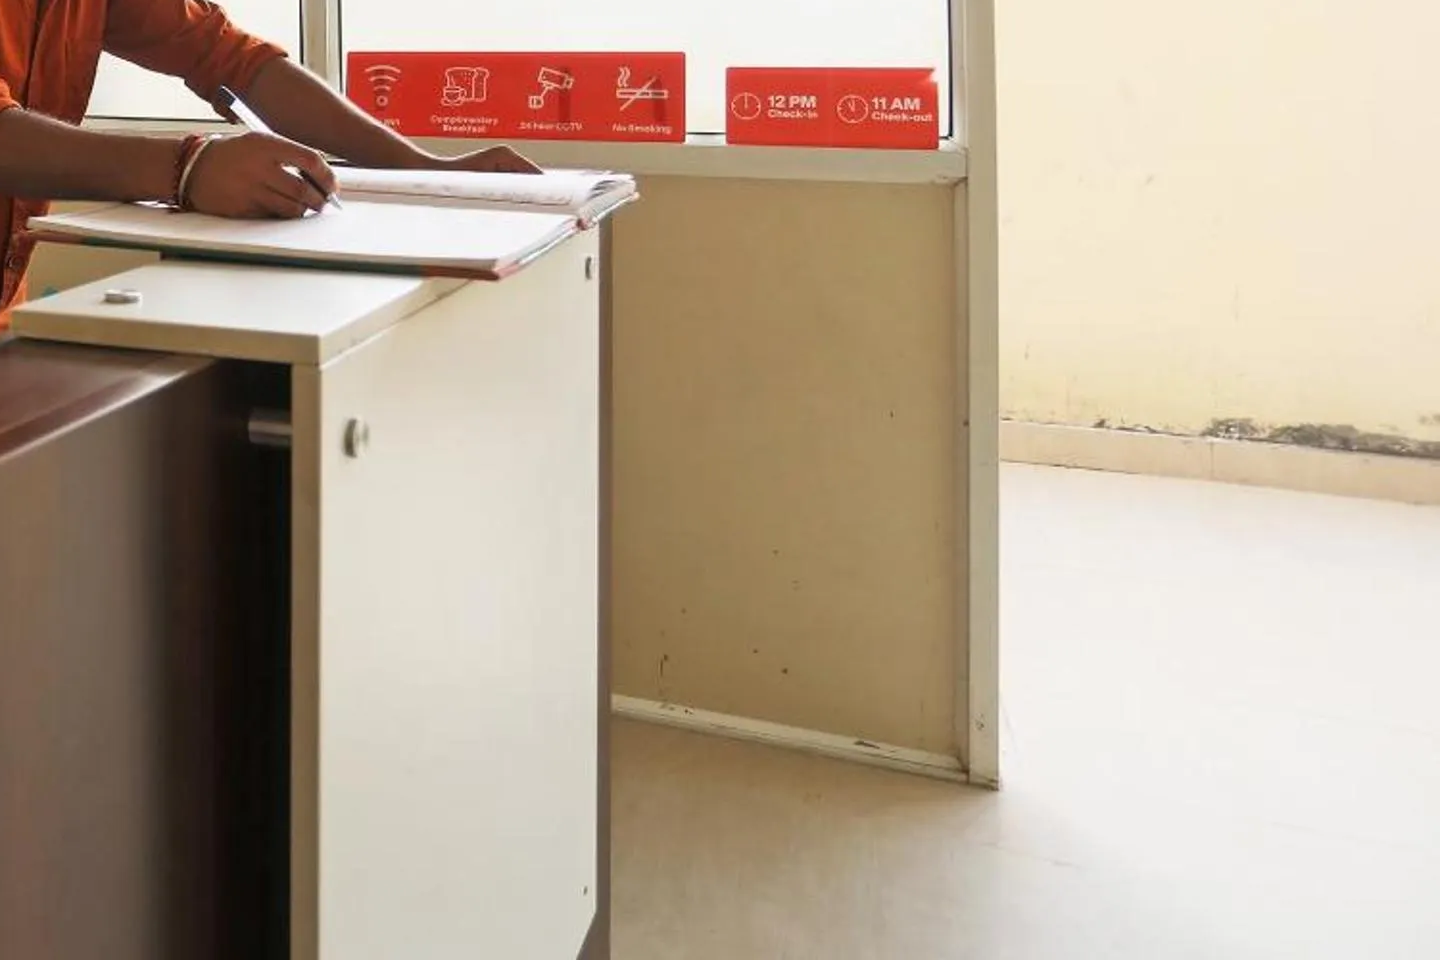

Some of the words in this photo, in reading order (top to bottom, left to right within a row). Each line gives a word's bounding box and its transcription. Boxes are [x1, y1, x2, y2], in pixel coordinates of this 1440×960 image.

[768, 95, 785, 108] 12
[789, 95, 817, 108] PM
[872, 97, 888, 110] 11
[890, 97, 921, 110] AM
[767, 109, 819, 119] Check-in
[871, 111, 933, 122] Check-out
